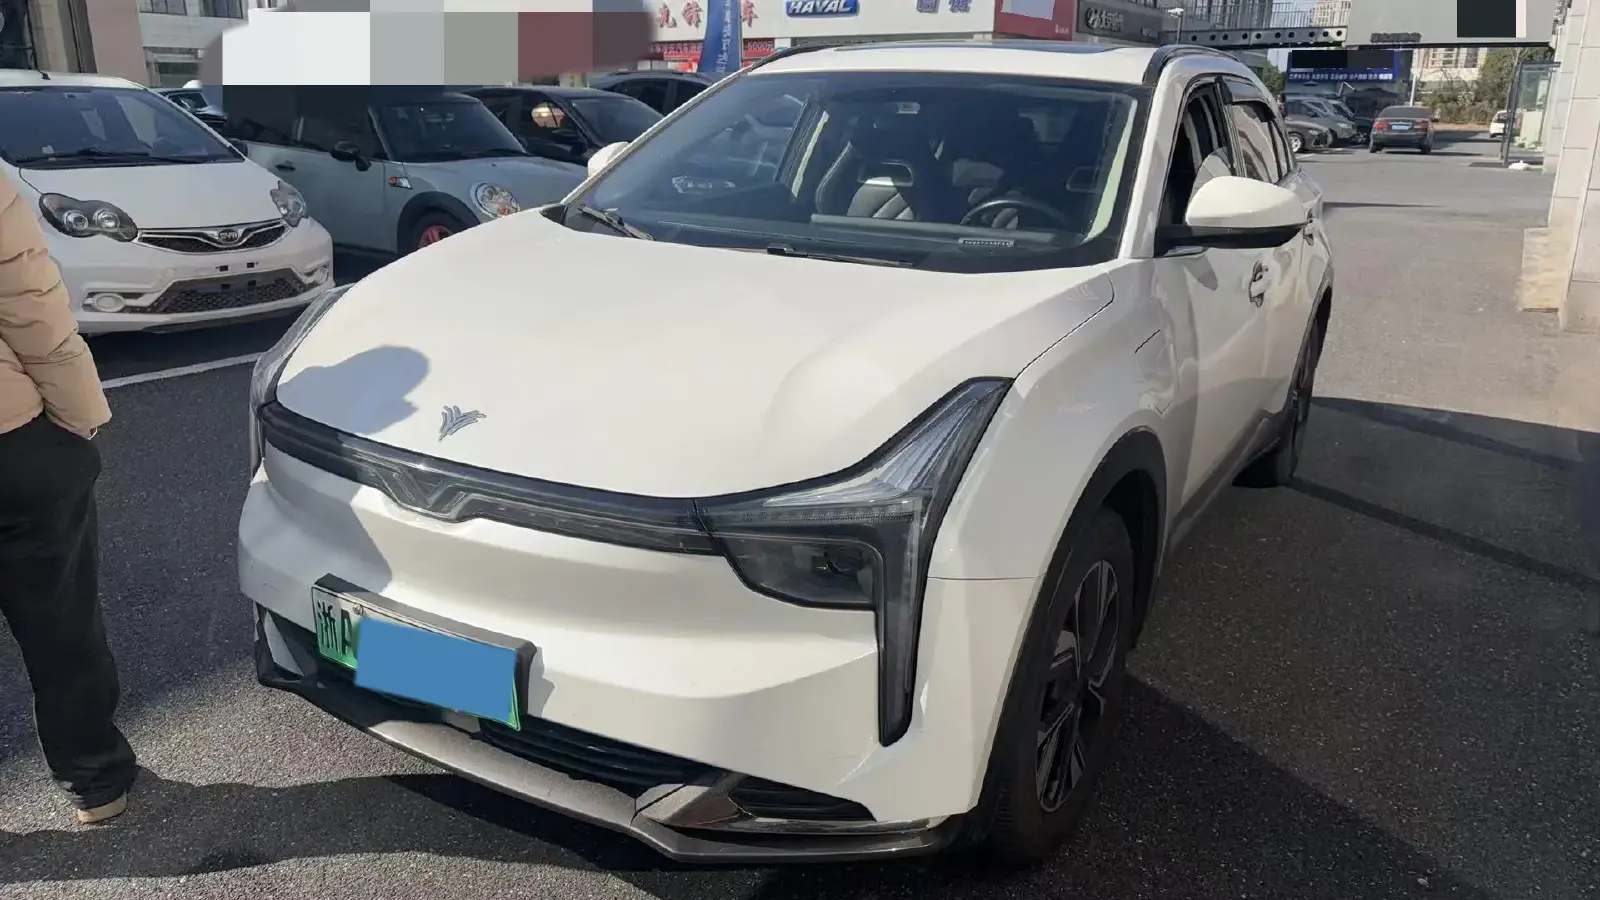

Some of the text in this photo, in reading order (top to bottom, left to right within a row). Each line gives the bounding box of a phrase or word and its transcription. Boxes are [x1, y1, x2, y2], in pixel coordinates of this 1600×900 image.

[658, 0, 758, 28] 九锋车
[788, 0, 852, 14] HAVAL
[317, 599, 357, 661] 浙A
